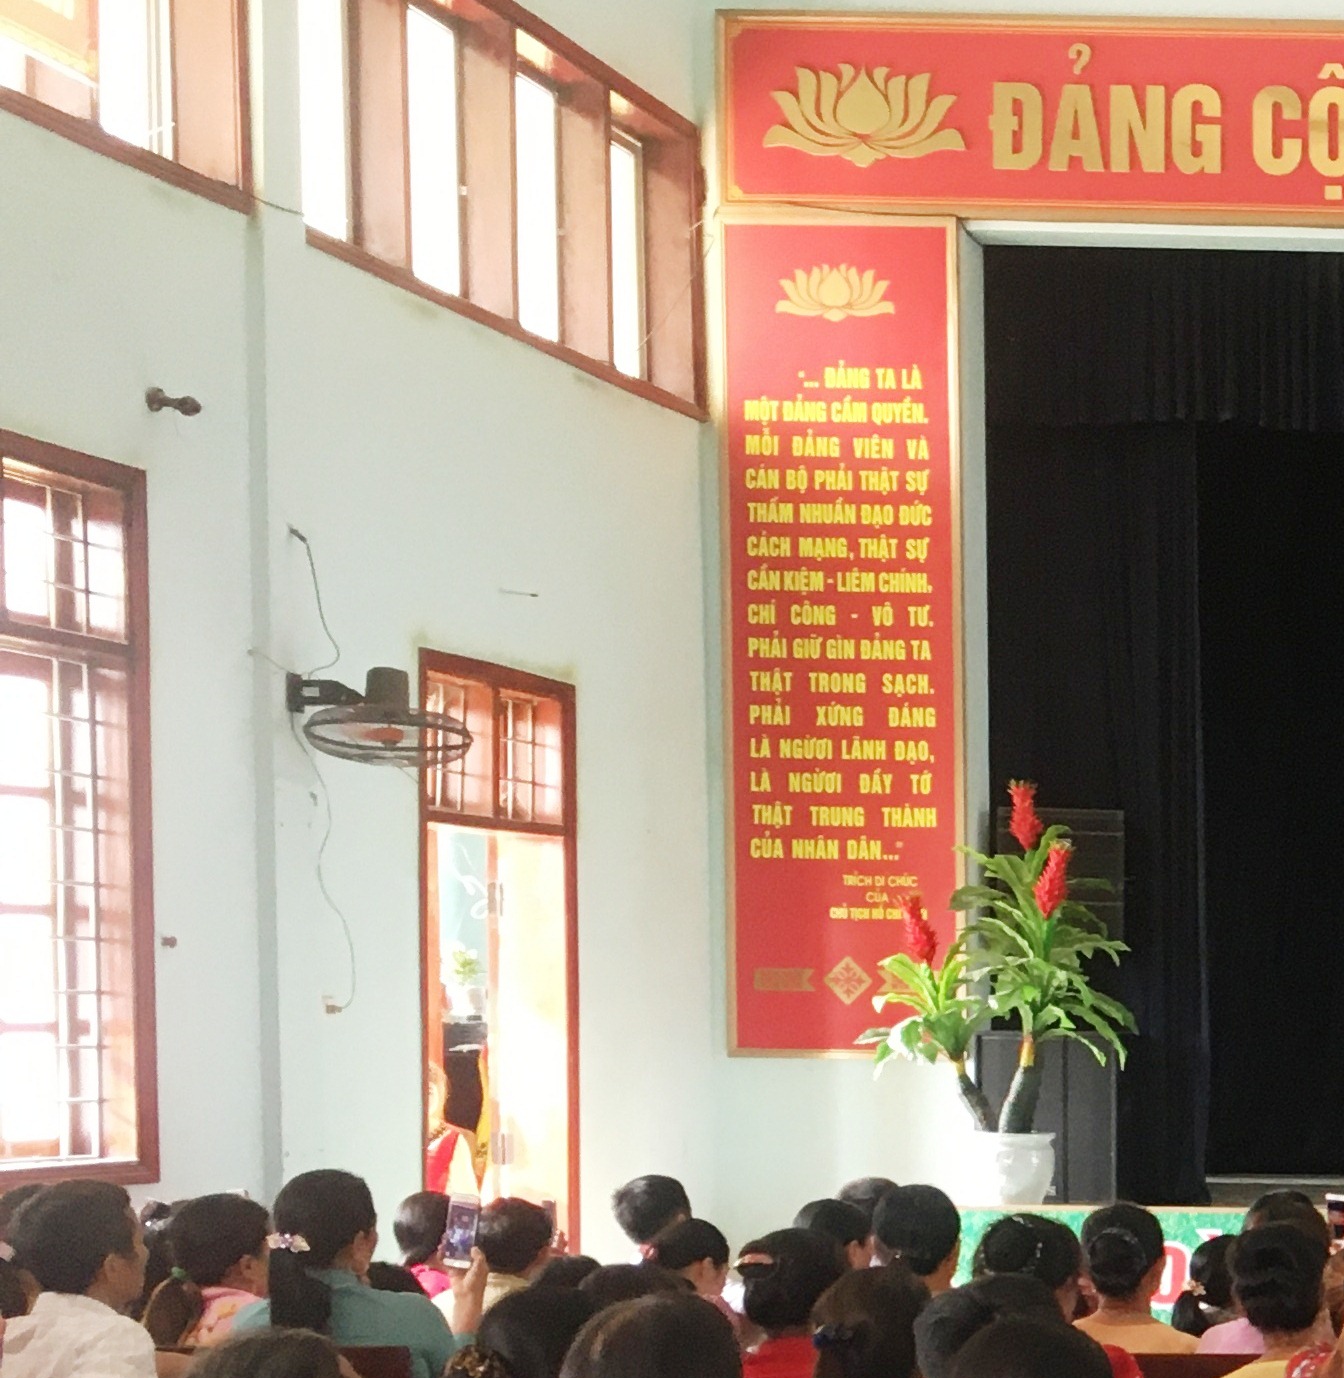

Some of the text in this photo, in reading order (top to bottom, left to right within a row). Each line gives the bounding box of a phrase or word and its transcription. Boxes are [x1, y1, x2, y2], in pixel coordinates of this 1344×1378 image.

[990, 44, 1222, 175] ĐẢNG
[824, 360, 922, 389] ĐẢNG TA LÀ
[744, 395, 779, 425] MỘT
[782, 394, 827, 422] ĐẢNG
[831, 395, 868, 423] CẦM
[745, 427, 929, 460] MỖI ĐẢNG VIÊN VÀ
[745, 463, 929, 495] CÁN BỘ PHẢI THẬT SỰ
[747, 497, 932, 529] THẤM NHUẦN ĐẠO ĐỨC
[747, 531, 930, 563] CÁCH MẠNG, THẬT SỰ
[747, 563, 780, 591] CẦN
[783, 567, 824, 595] KIỆM
[837, 567, 875, 592] LIÊM
[748, 599, 776, 624] CHÍ
[790, 600, 836, 625] CÔNG
[872, 602, 894, 627] VÔ
[748, 630, 932, 660] PHẢI GIỮ GÌN ĐẢNG TA
[750, 667, 792, 695] THẬT
[809, 672, 866, 693] TRONG
[750, 698, 936, 728] PHẢI XỨNG ĐÁNG
[750, 734, 771, 758] LÀ
[841, 736, 886, 760] LÃNH
[750, 768, 771, 792] LÀ
[910, 770, 932, 795] TỚ
[752, 801, 937, 829] THẬT TRUNG THÀNH
[750, 831, 784, 858] CỦA
[792, 835, 839, 859] NHÂN
